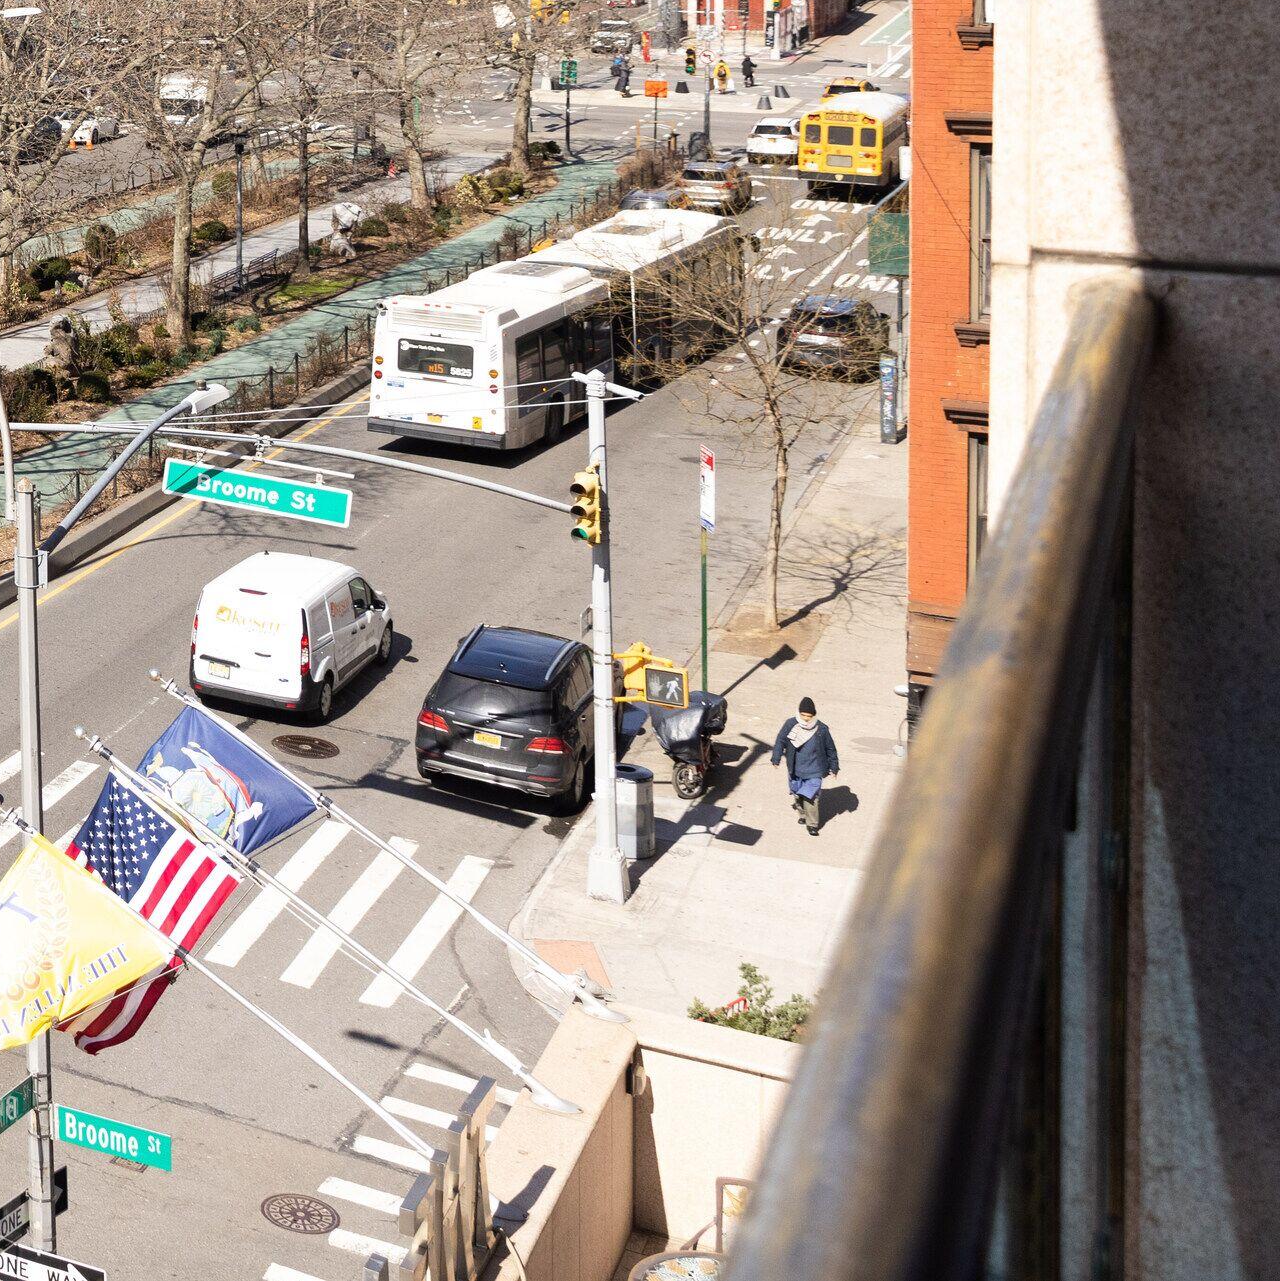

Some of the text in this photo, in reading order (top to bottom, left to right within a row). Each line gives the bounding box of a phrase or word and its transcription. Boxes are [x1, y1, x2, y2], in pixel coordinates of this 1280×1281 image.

[791, 199, 876, 214] ONLY
[755, 227, 845, 244] ONLY
[428, 363, 444, 373] M15
[196, 472, 316, 512] Broome St
[65, 1112, 162, 1157] Broome St
[0, 1208, 22, 1237] ONE
